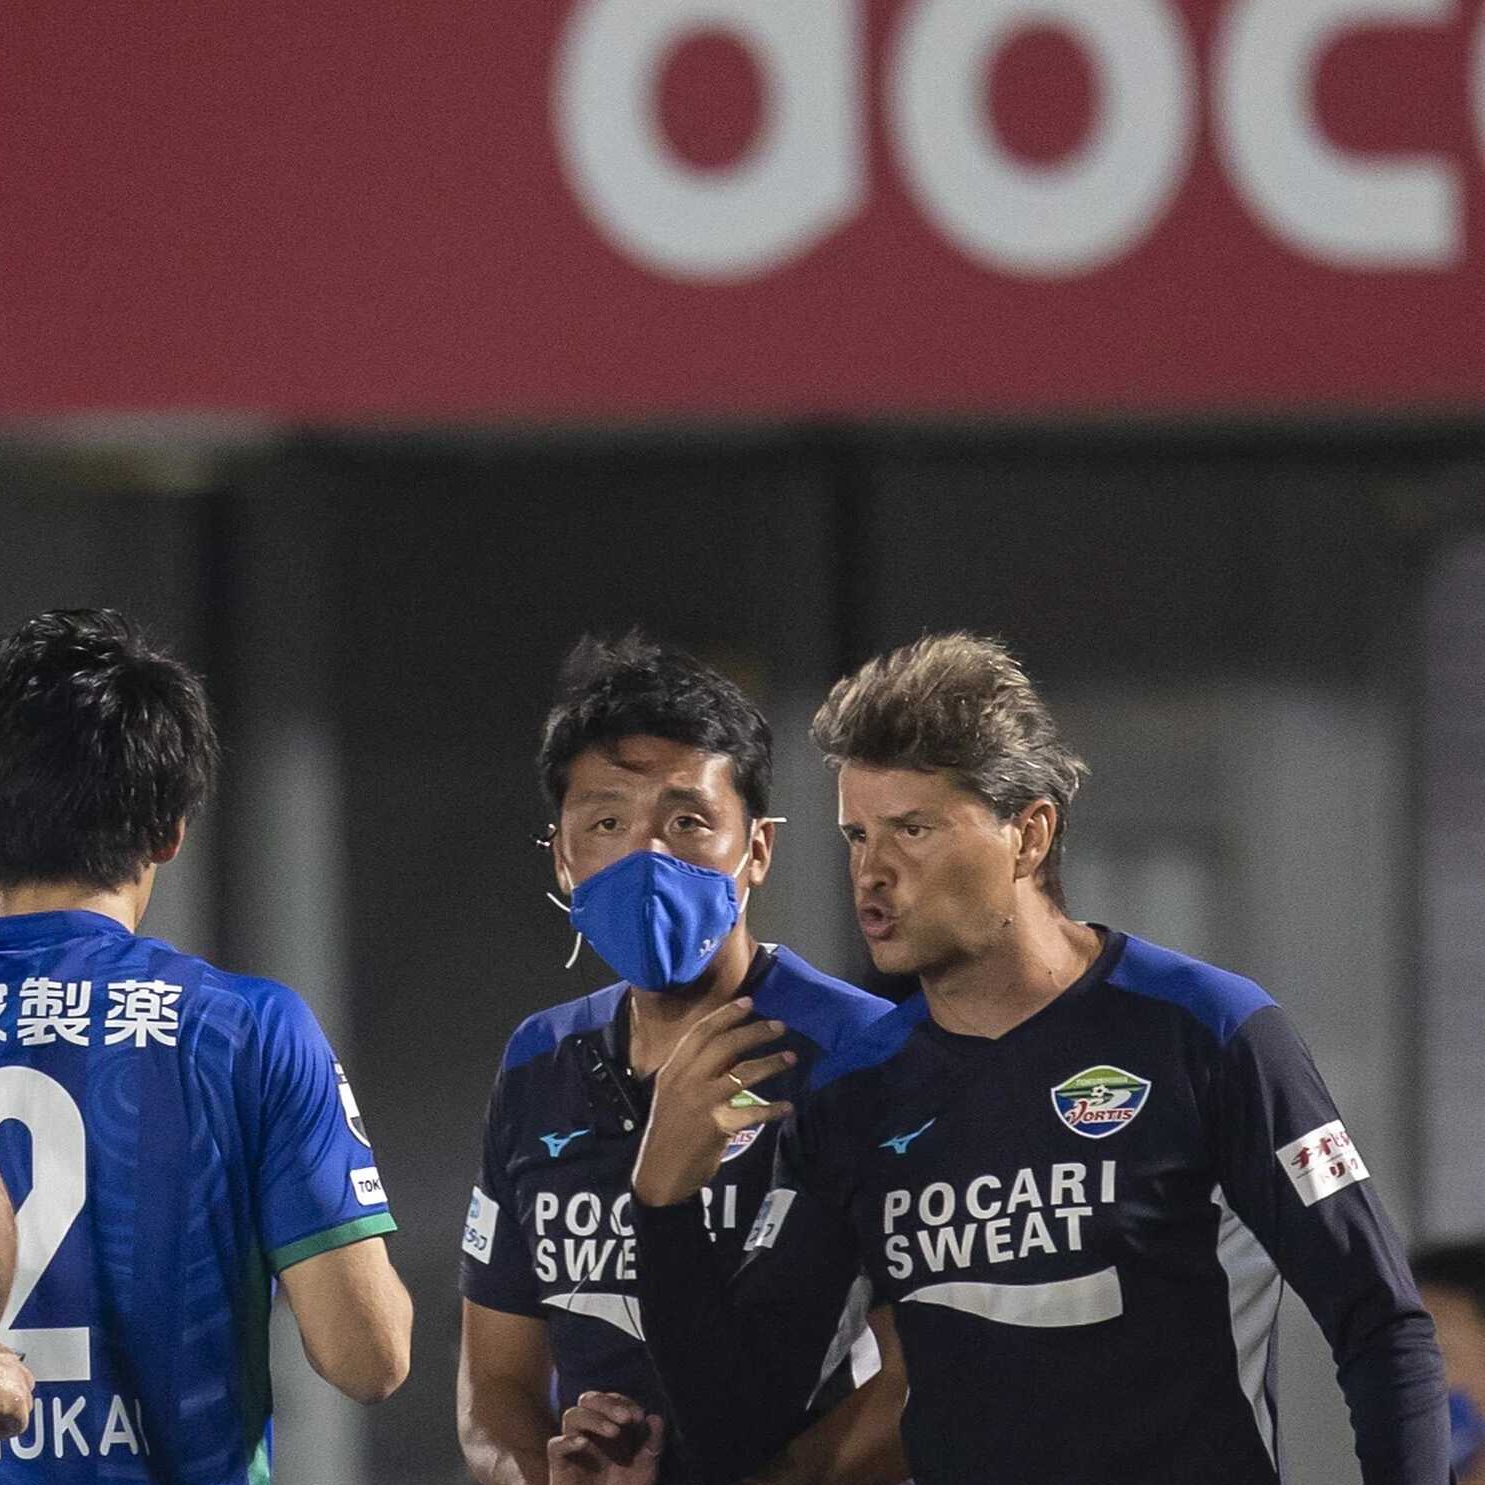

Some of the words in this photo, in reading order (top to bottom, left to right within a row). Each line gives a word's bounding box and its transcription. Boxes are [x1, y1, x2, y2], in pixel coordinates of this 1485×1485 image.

[550, 0, 1485, 285] doc
[884, 1160, 1116, 1235] POCARI
[885, 1206, 1093, 1281] SWEAT
